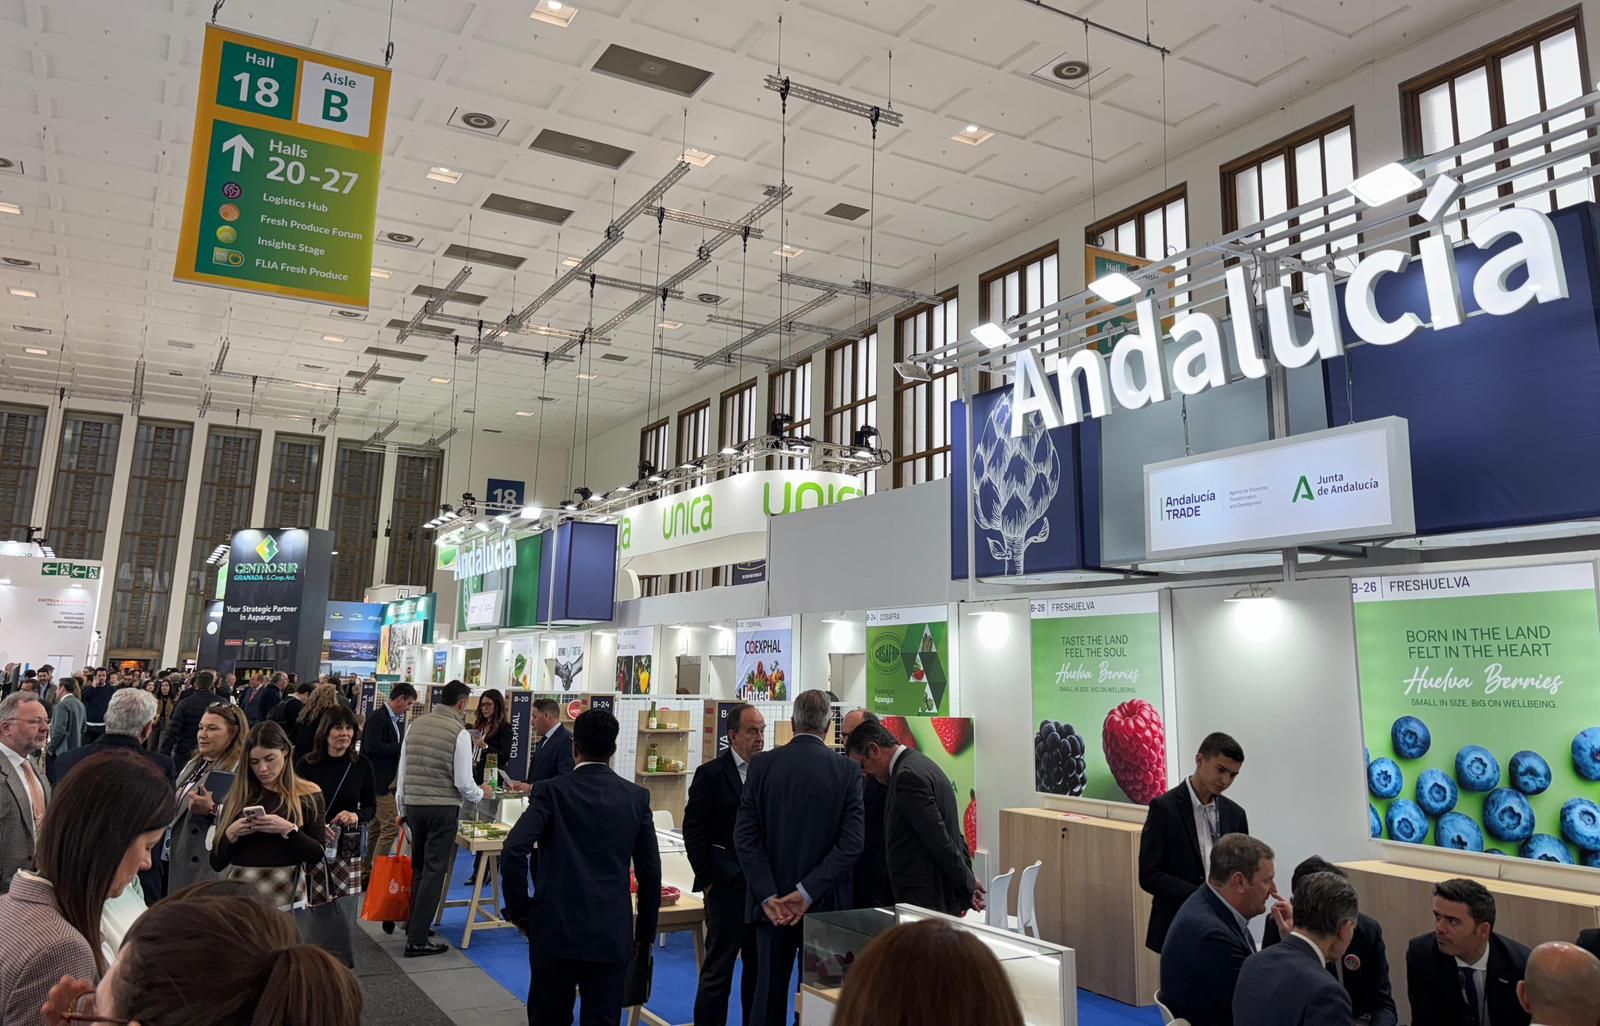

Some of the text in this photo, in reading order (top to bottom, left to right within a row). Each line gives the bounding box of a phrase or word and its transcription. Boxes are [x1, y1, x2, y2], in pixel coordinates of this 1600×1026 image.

[246, 51, 275, 69] Hall
[321, 71, 357, 89] Aisle
[232, 71, 280, 109] 18
[321, 88, 349, 123] B
[269, 139, 308, 159] Halls
[263, 192, 328, 213] Logistics Hub
[260, 214, 363, 241] Fresh Produce Forum
[257, 236, 326, 257] Insights Stage
[255, 258, 349, 282] FLIA Fresh Produce
[1010, 173, 1569, 439] Andalucía
[1316, 472, 1344, 486] Junta
[1317, 477, 1379, 496] de Andalucía
[492, 488, 516, 505] 18
[1165, 489, 1216, 507] Andalucía
[1166, 505, 1201, 521] TRADE
[454, 523, 517, 581] Andalucía
[235, 562, 298, 574] CENTRO SUR
[1389, 576, 1470, 593] FRESHUELVA
[227, 605, 298, 614] Your Strategic Partner
[1052, 601, 1095, 612] FRESHUELVA
[247, 614, 281, 622] Asparagus
[1061, 634, 1129, 646] TASTE THE LAND
[1406, 625, 1551, 643] BORN IN THE LAND
[745, 639, 782, 654] COEXPHAL
[1065, 647, 1127, 658] FEEL THE SOUL
[1408, 643, 1551, 659] FELT IN THE HEART
[1056, 661, 1140, 684] Huelva Berries
[1402, 663, 1563, 695] Huelva Berries
[741, 685, 771, 701] United
[1411, 698, 1437, 707] SMALL
[1439, 699, 1448, 707] IN
[1471, 699, 1486, 708] BIG
[1488, 699, 1501, 708] ON
